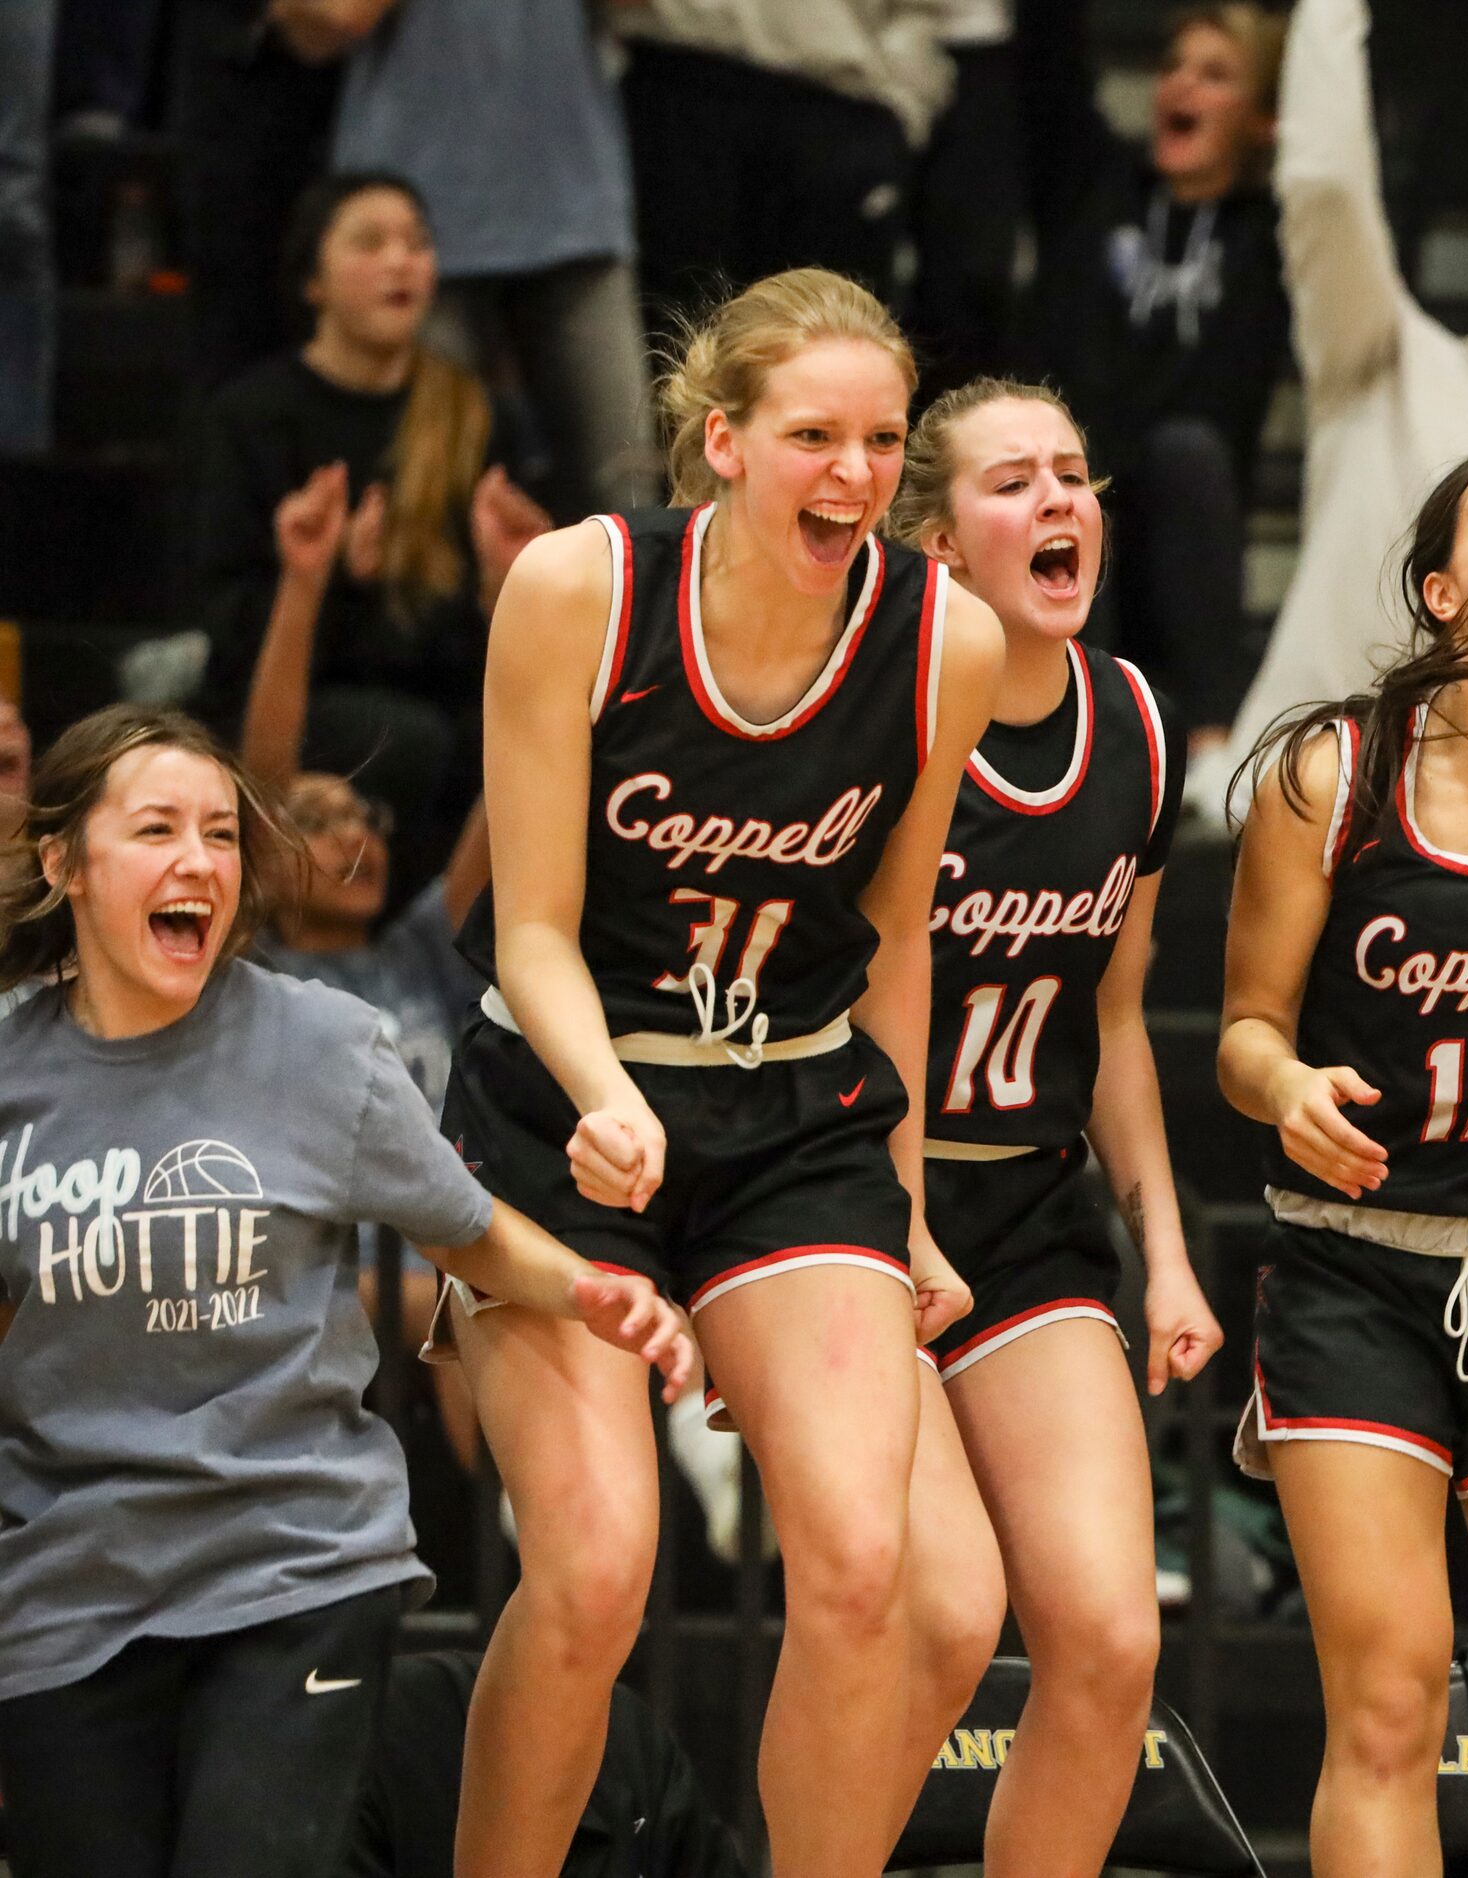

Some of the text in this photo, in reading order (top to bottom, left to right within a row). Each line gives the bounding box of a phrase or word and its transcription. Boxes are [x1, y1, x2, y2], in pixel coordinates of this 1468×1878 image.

[606, 771, 882, 874] Coppell
[652, 887, 795, 999] 31
[941, 975, 1062, 1114] 10
[38, 1206, 271, 1305] HOTTIE
[145, 1285, 265, 1333] 2021-2022
